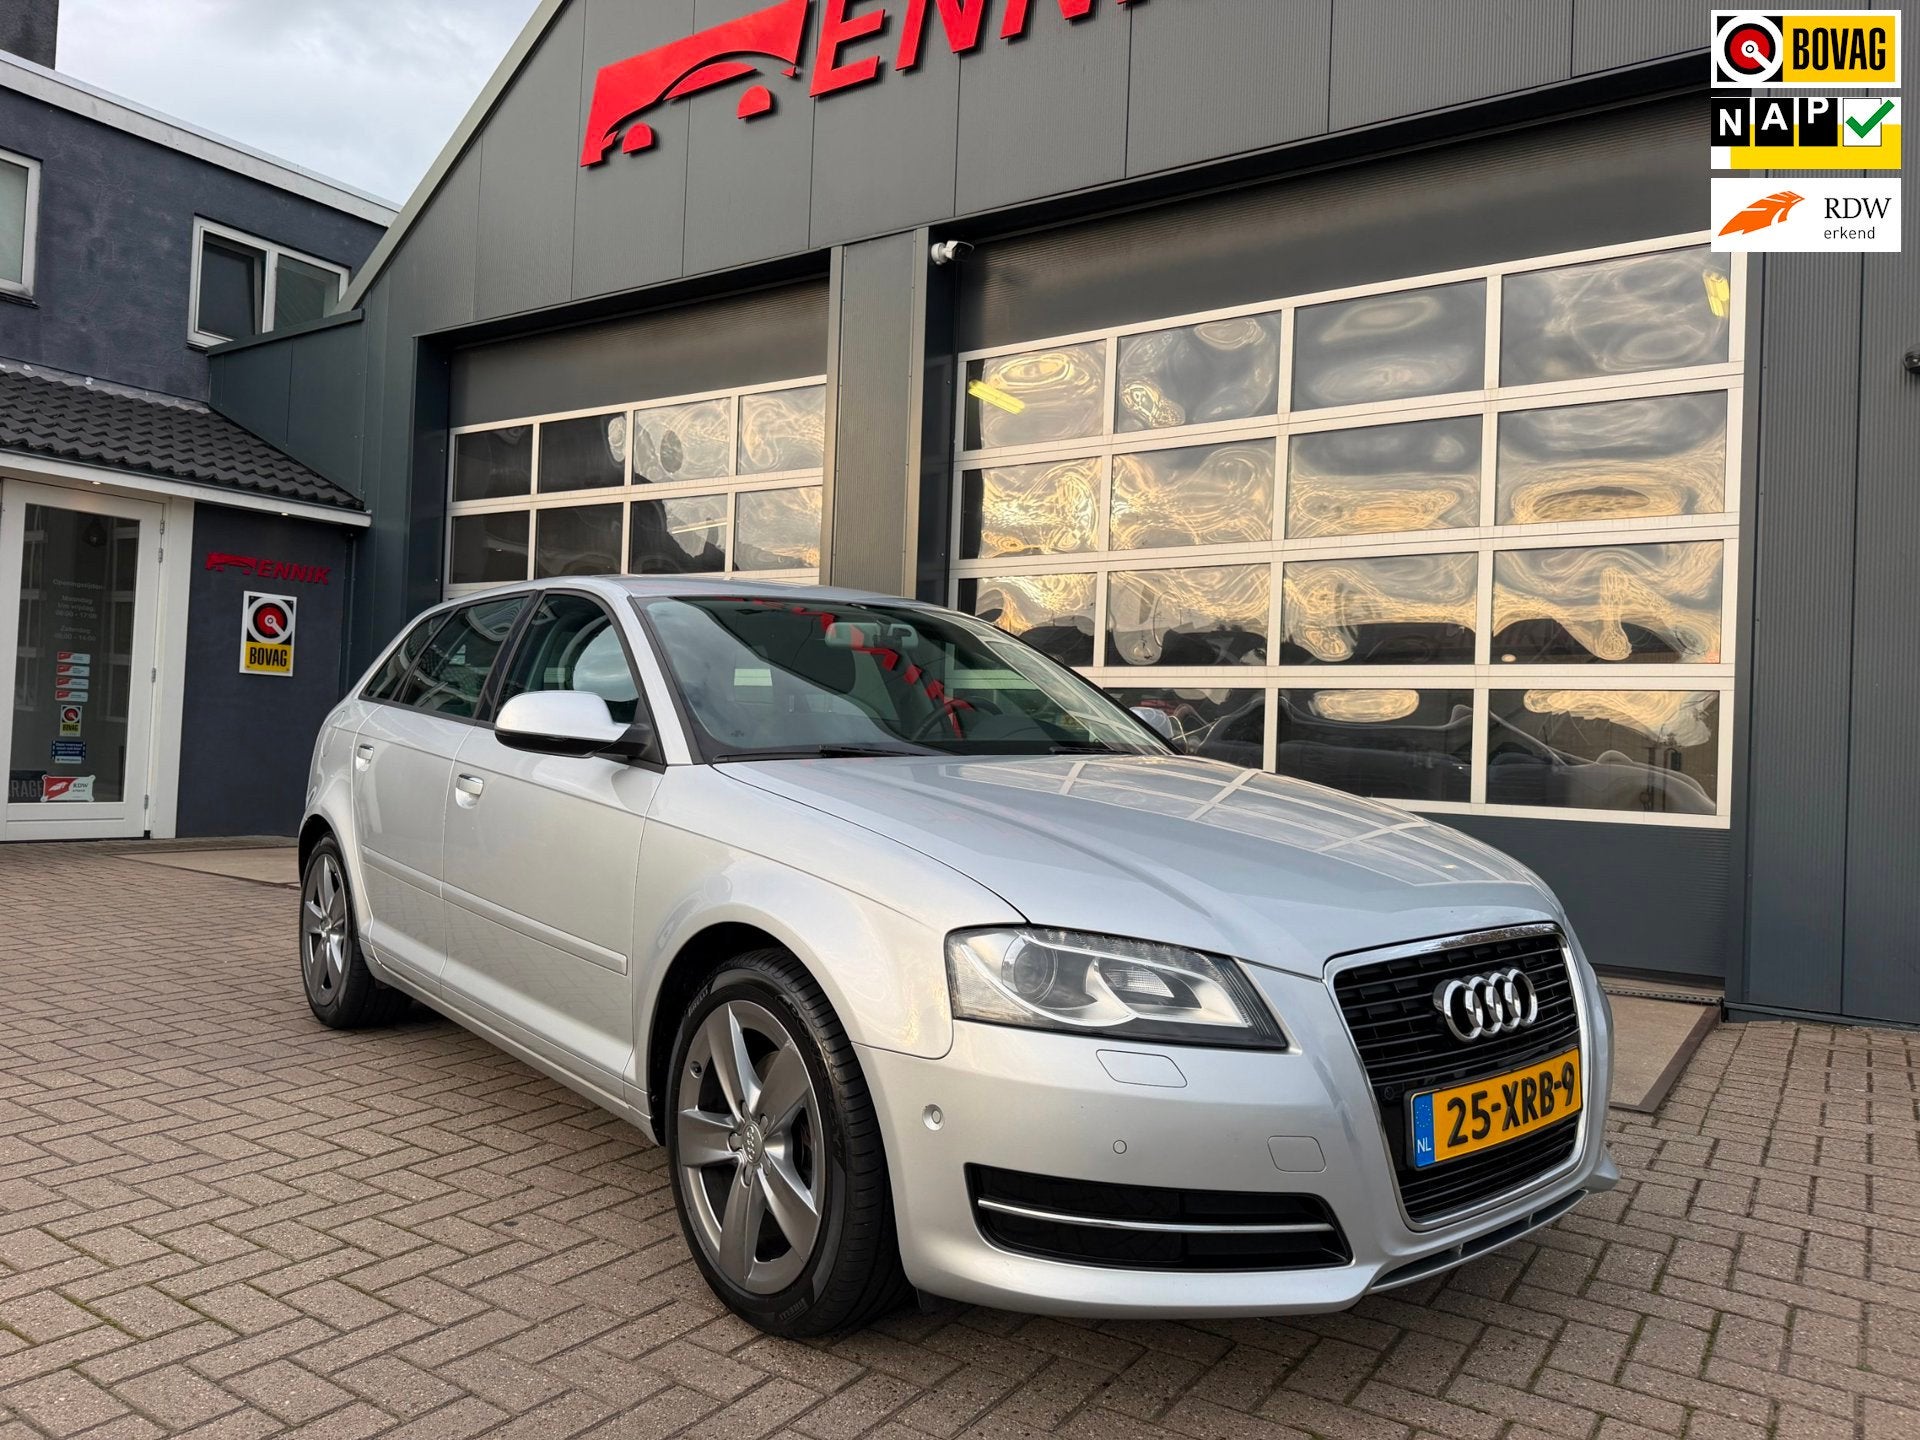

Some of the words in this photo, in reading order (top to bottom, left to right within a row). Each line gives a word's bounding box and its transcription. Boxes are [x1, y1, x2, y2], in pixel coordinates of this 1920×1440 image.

[809, 0, 1129, 97] EN
[249, 646, 288, 667] BOVAG
[1446, 1061, 1575, 1148] 25-XRB-9
[1417, 1138, 1432, 1154] NL
